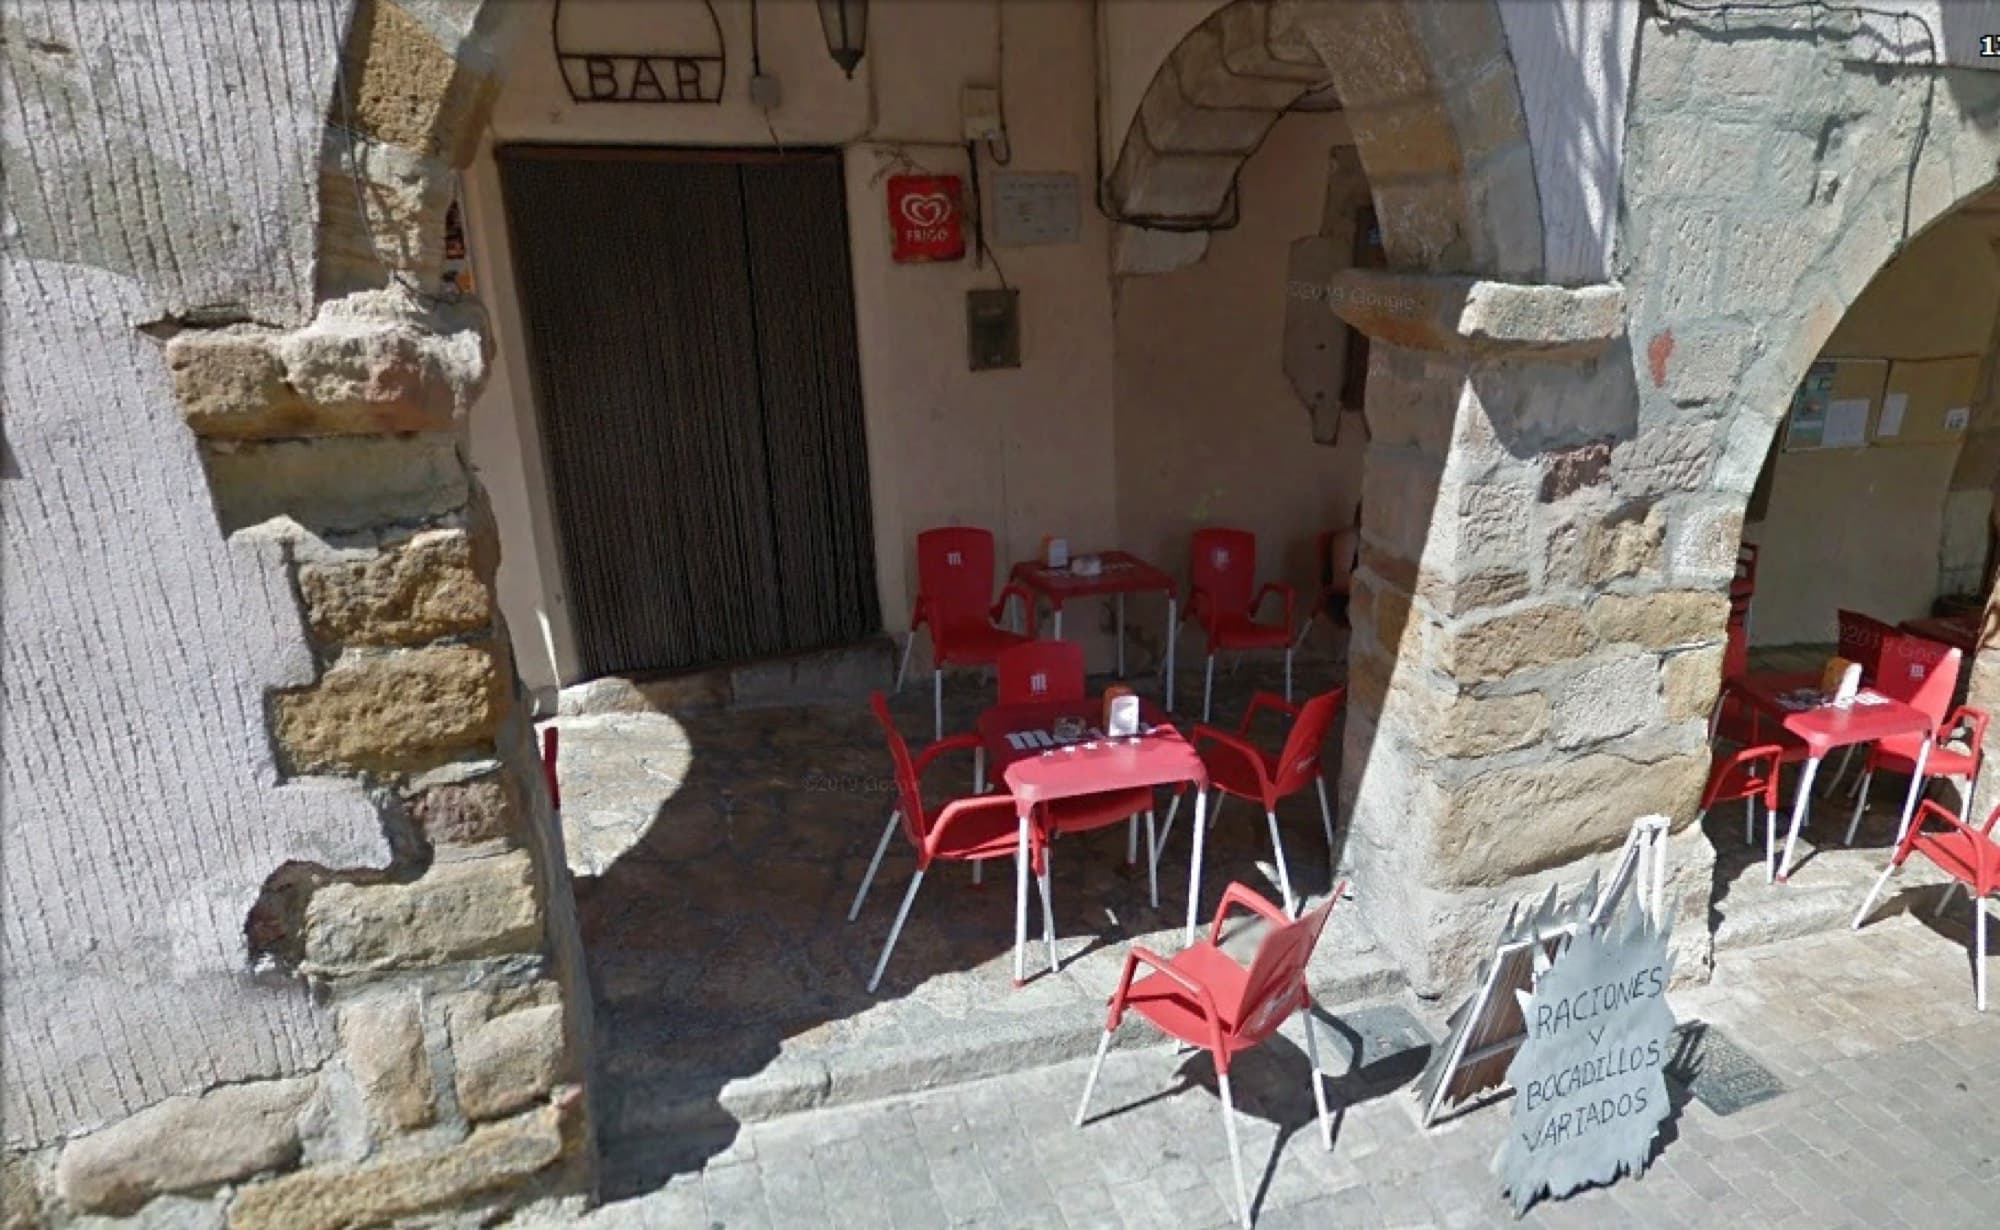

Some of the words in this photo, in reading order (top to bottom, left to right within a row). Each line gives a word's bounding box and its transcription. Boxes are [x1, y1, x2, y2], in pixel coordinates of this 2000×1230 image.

[584, 55, 703, 102] BAR
[905, 228, 949, 242] FRIGO
[1536, 966, 1663, 1038] RACIONES
[1526, 1039, 1661, 1111] BOCADILLOS
[1521, 1087, 1648, 1152] VARIADOS
